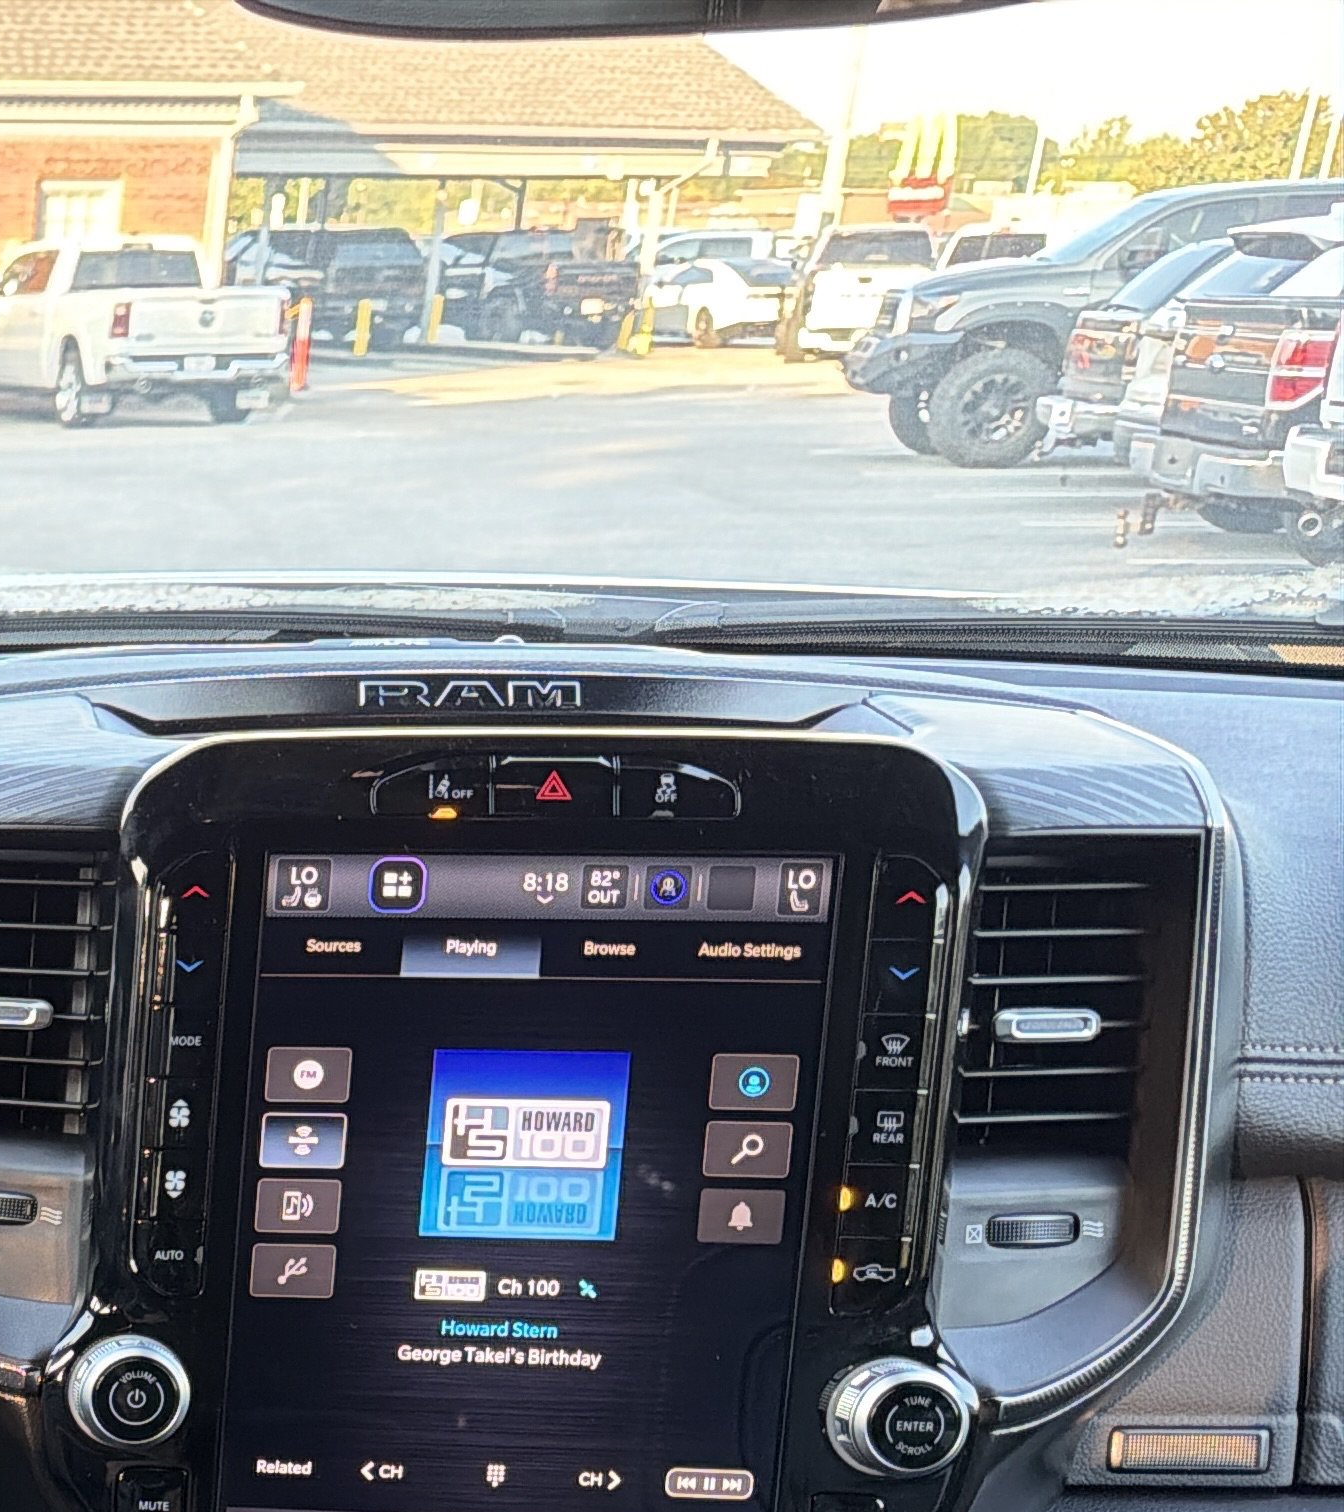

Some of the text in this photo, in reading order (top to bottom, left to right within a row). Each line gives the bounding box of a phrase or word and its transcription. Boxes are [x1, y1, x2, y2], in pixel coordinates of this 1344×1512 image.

[359, 680, 581, 708] RAM
[451, 789, 474, 800] OFF
[654, 792, 678, 803] OFF
[290, 866, 318, 885] LO
[522, 872, 569, 893] 8:18
[590, 870, 621, 887] 82°
[787, 868, 817, 890] LO
[587, 890, 621, 904] OUT
[306, 938, 362, 953] Sources
[446, 939, 497, 957] Playing
[583, 941, 636, 956] Browse
[698, 942, 802, 960] Audio Settings
[170, 1035, 202, 1046] MODE
[876, 1056, 914, 1068] FRONT
[299, 1070, 317, 1079] FM
[522, 1110, 595, 1132] HOWARD
[519, 1133, 597, 1158] 100
[873, 1132, 904, 1144] REAR
[864, 1193, 897, 1209] A/C
[154, 1250, 184, 1261] AUTO
[498, 1278, 522, 1295] Ch
[528, 1279, 560, 1296] 100
[441, 1320, 558, 1339] Howard Stern
[397, 1345, 602, 1370] George Takei's Birthday
[119, 1369, 157, 1385] VOLUME
[903, 1395, 932, 1408] TUNE
[896, 1421, 934, 1432] ENTER
[895, 1441, 933, 1456] SCROLL
[256, 1459, 312, 1476] Related
[379, 1464, 404, 1480] CH
[578, 1471, 603, 1487] CH
[138, 1500, 170, 1511] MUTE
